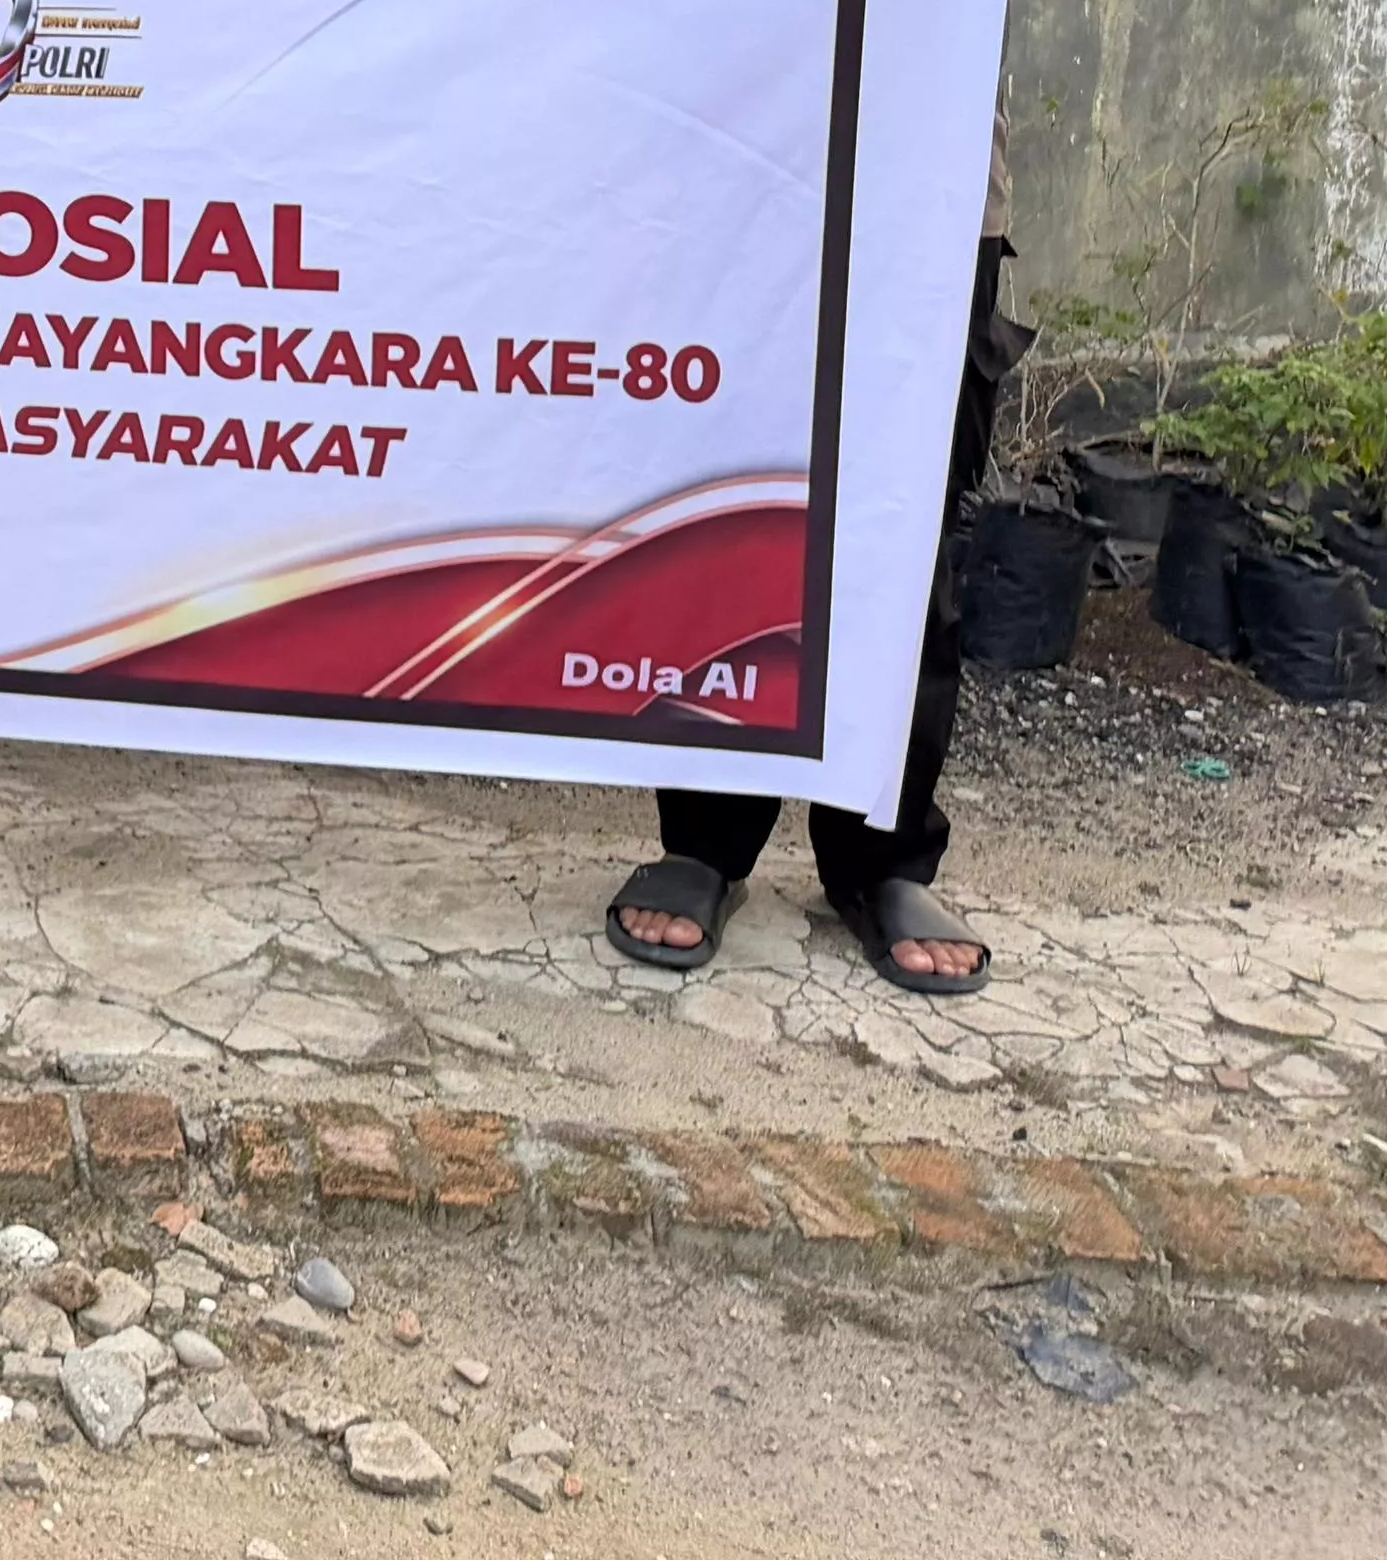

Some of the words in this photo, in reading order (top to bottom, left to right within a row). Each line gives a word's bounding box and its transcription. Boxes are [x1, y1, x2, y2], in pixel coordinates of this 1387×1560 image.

[21, 42, 111, 81] POLRI
[494, 338, 723, 404] KE-80
[561, 651, 684, 696] Dola
[698, 661, 758, 701] AI
